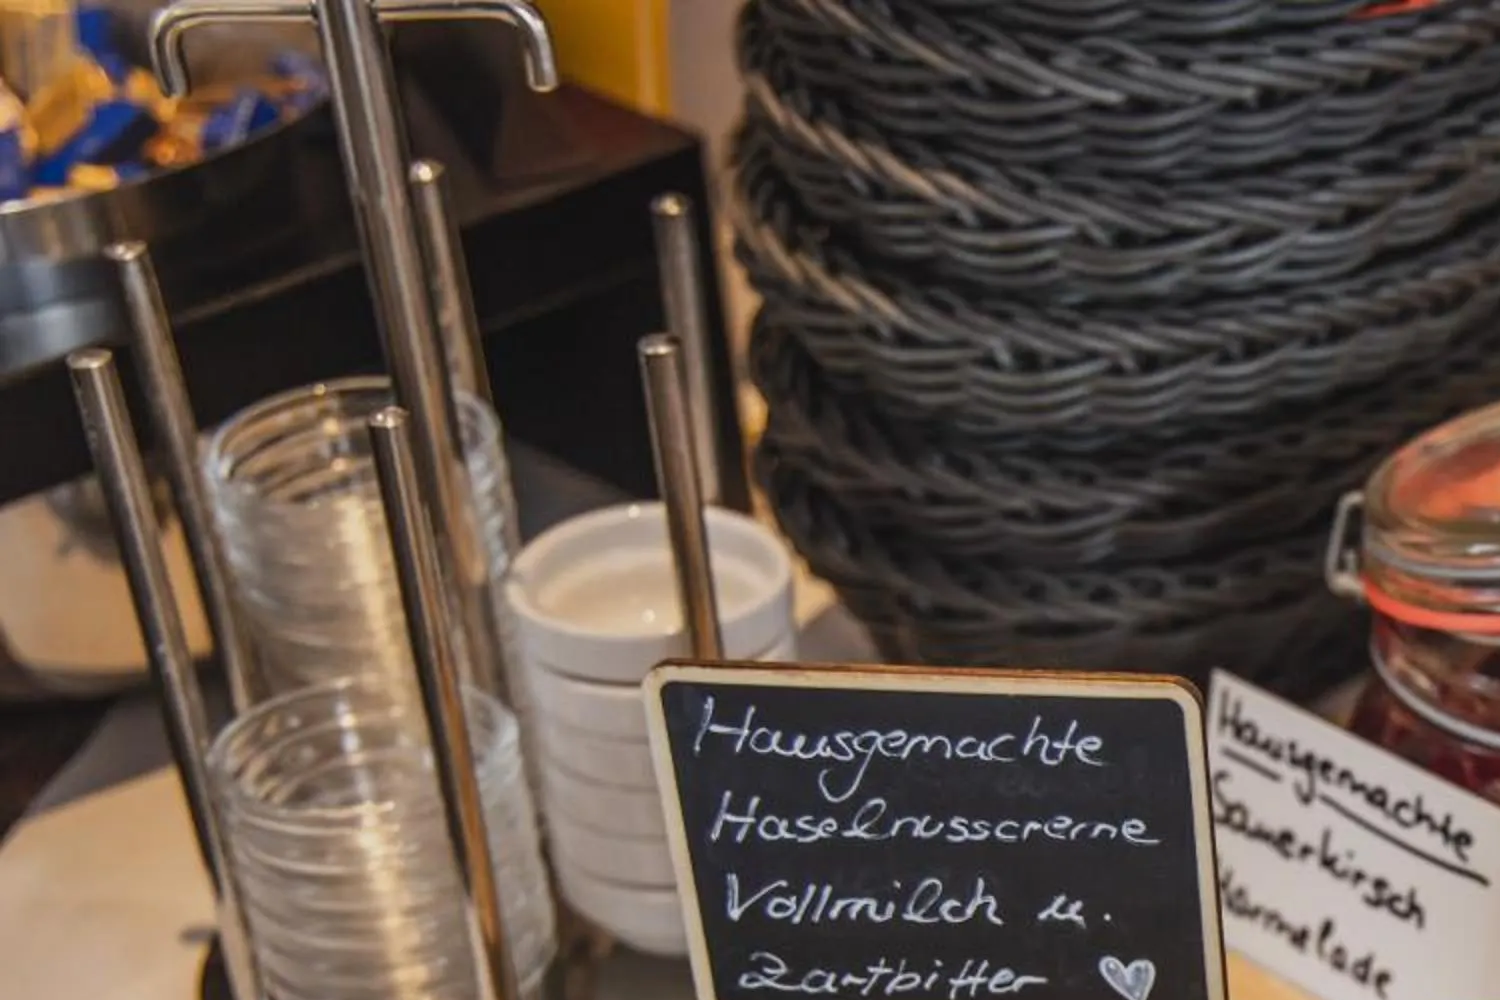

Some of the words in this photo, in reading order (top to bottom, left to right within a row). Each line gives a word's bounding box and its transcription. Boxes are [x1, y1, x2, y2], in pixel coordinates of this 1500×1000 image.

[693, 696, 1105, 803] Hausgemachte
[1217, 688, 1475, 864] Hausgemachte
[710, 790, 1162, 845] Haselnusscreme
[1212, 769, 1427, 932] Sauerkirsch
[725, 872, 1005, 925] Vollmilch
[1037, 896, 1114, 930] u.
[738, 952, 1049, 1000] Zartbitter
